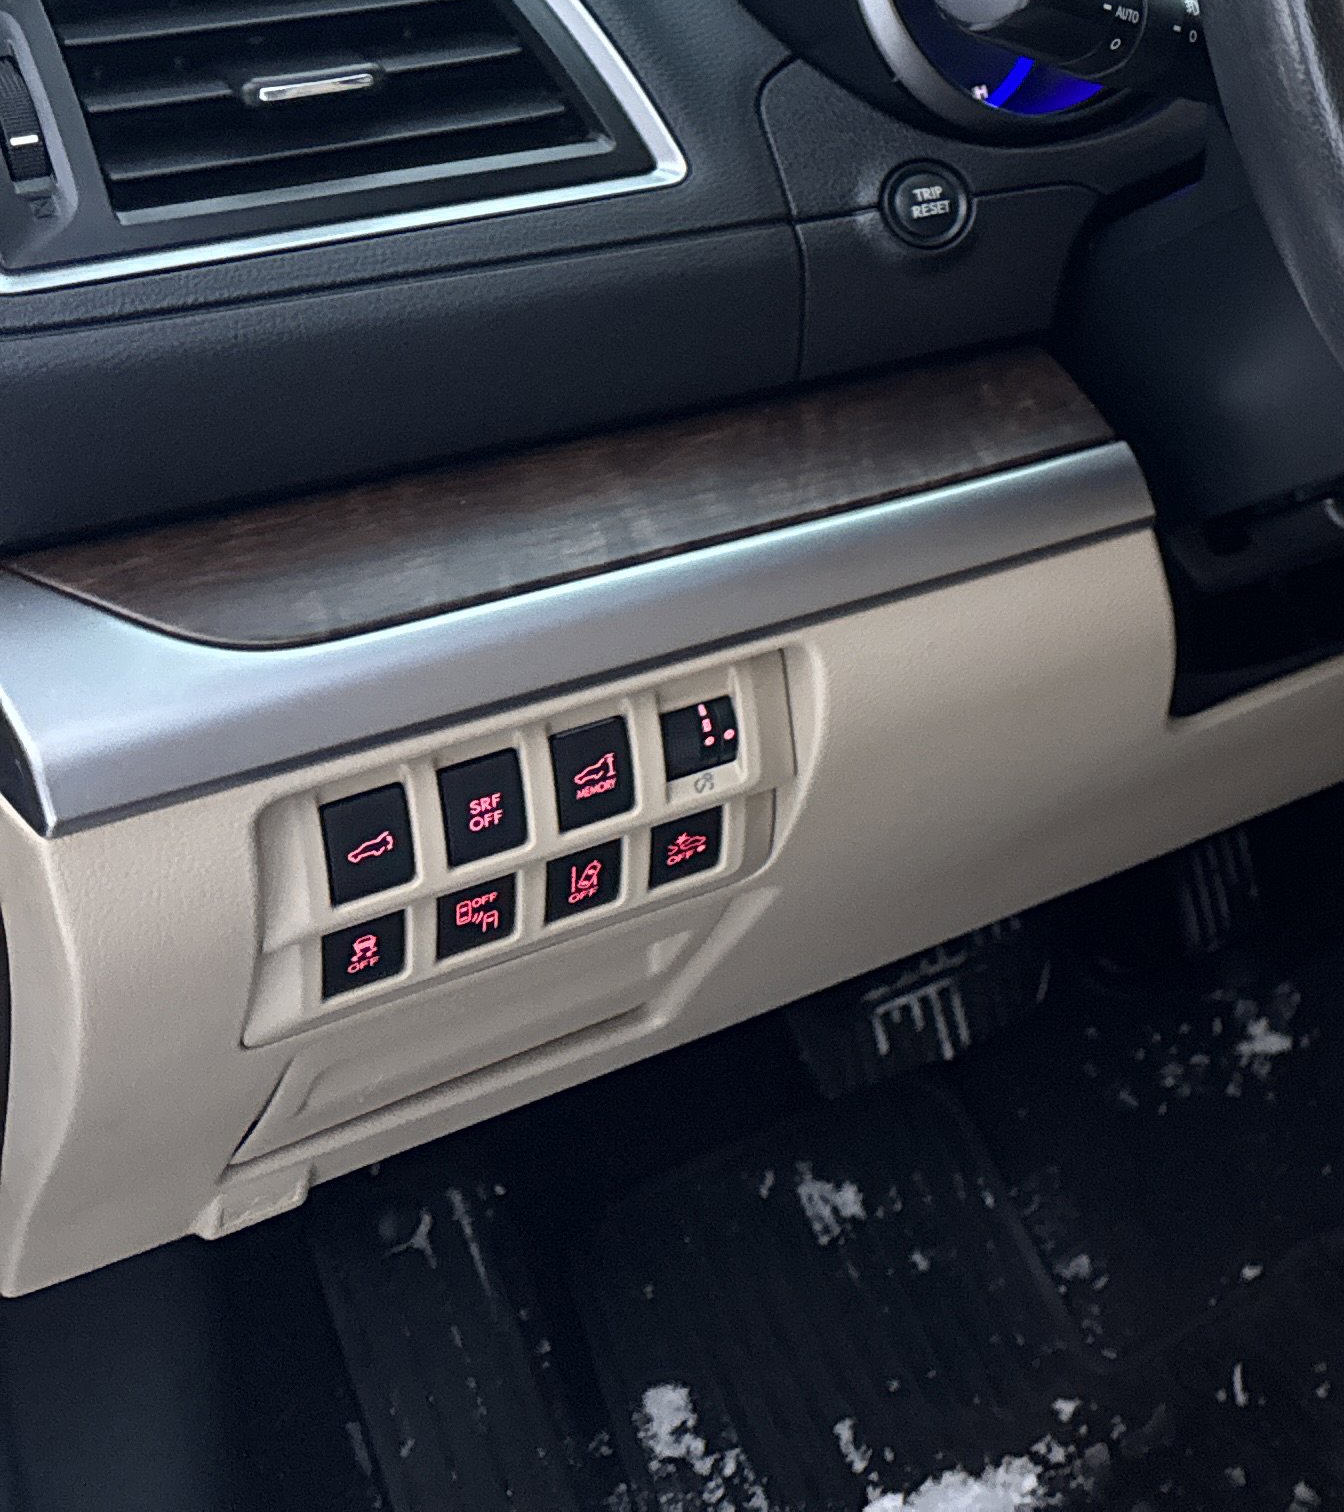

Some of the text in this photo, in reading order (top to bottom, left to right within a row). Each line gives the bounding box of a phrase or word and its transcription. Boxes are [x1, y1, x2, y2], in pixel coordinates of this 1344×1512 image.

[1115, 5, 1140, 24] AUTO
[911, 186, 943, 202] TRIP
[911, 199, 950, 220] RESET
[576, 777, 617, 800] MEMORY
[469, 792, 502, 815] SRF
[469, 810, 503, 832] OFF
[471, 891, 498, 908] OFF
[568, 886, 599, 904] OFF
[347, 956, 380, 973] OFF
